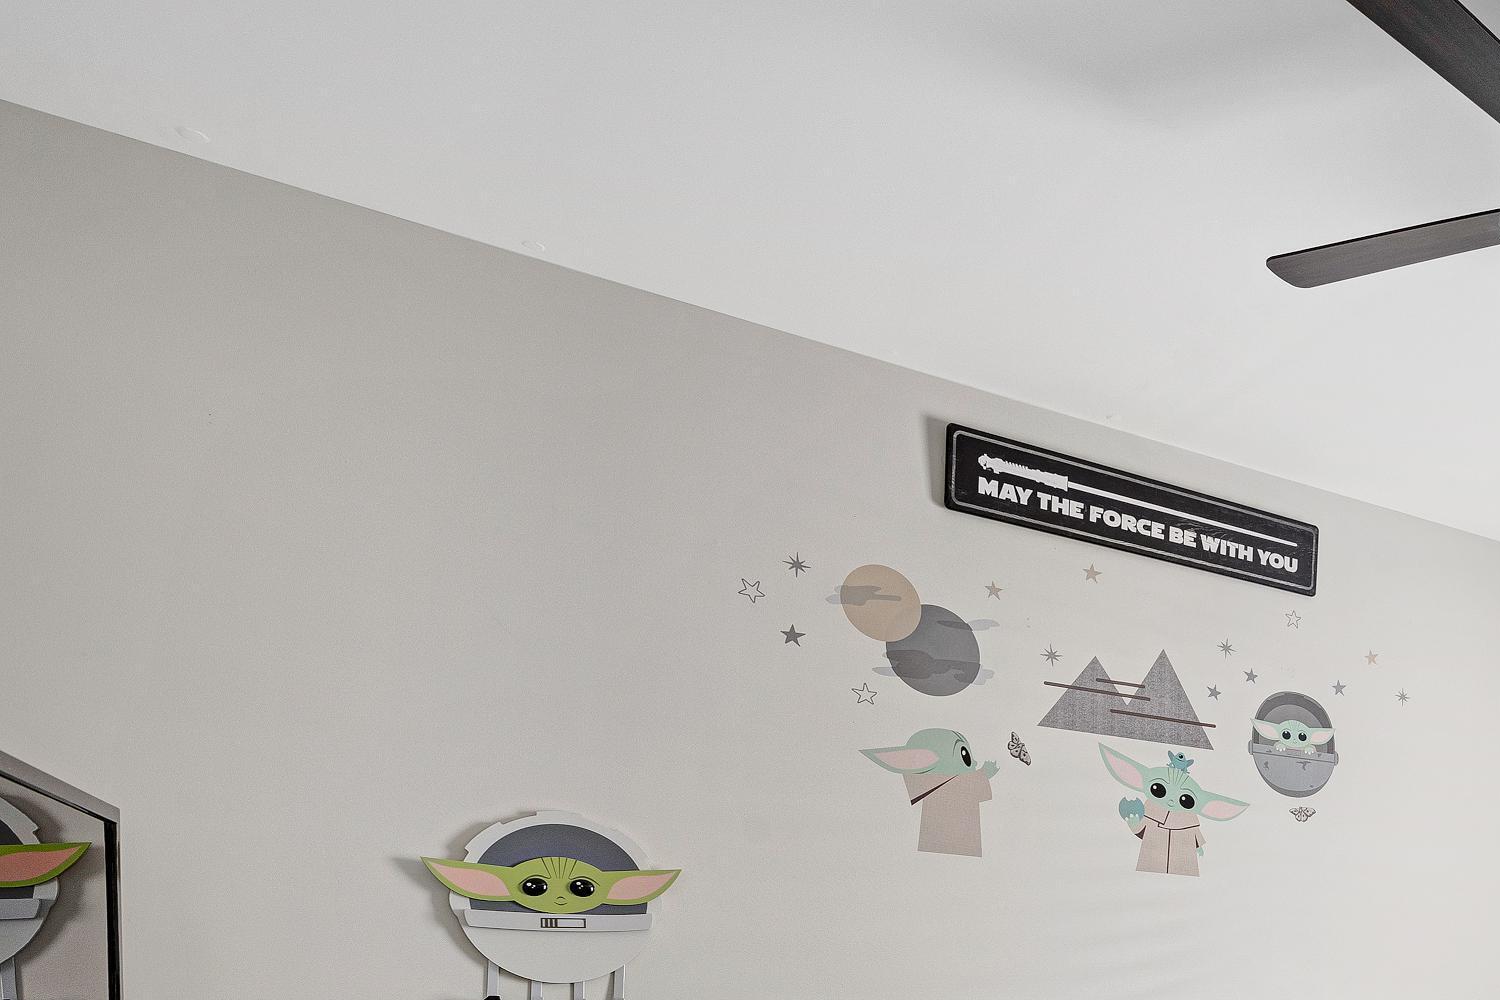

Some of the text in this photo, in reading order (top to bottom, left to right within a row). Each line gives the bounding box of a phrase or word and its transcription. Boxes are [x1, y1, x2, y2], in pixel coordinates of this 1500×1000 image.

[978, 476, 1299, 574] MAY THE FORCE BE WITH YOU
